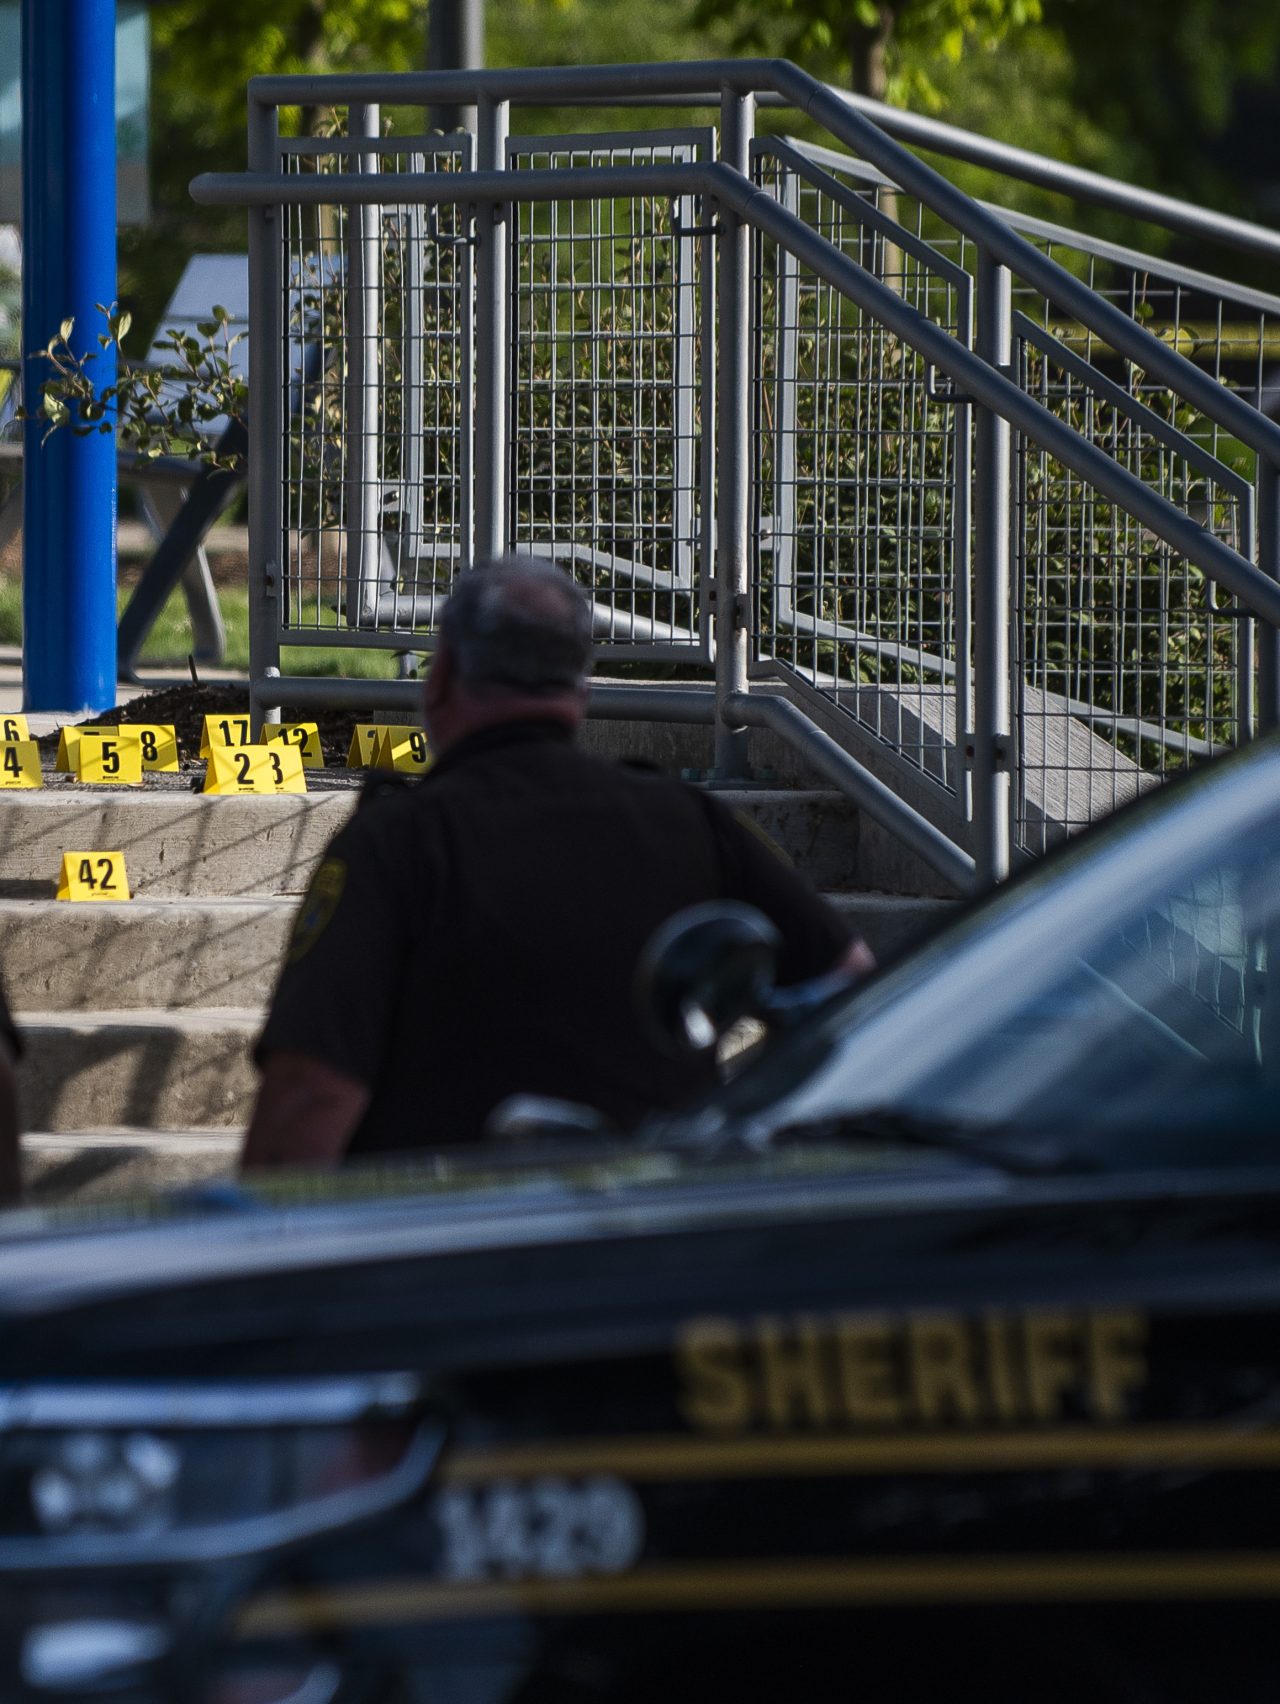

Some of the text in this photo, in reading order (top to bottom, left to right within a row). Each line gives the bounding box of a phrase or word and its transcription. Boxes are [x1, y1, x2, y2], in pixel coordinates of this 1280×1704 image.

[140, 730, 158, 762] 8
[219, 719, 248, 747] 17
[278, 727, 313, 758] 12
[409, 731, 427, 763] 9
[3, 746, 24, 778] 4
[101, 741, 120, 774] 5
[234, 752, 255, 785] 2
[78, 858, 117, 890] 42
[678, 1308, 1148, 1428] SHERIFF
[436, 1475, 645, 1581] 1429
